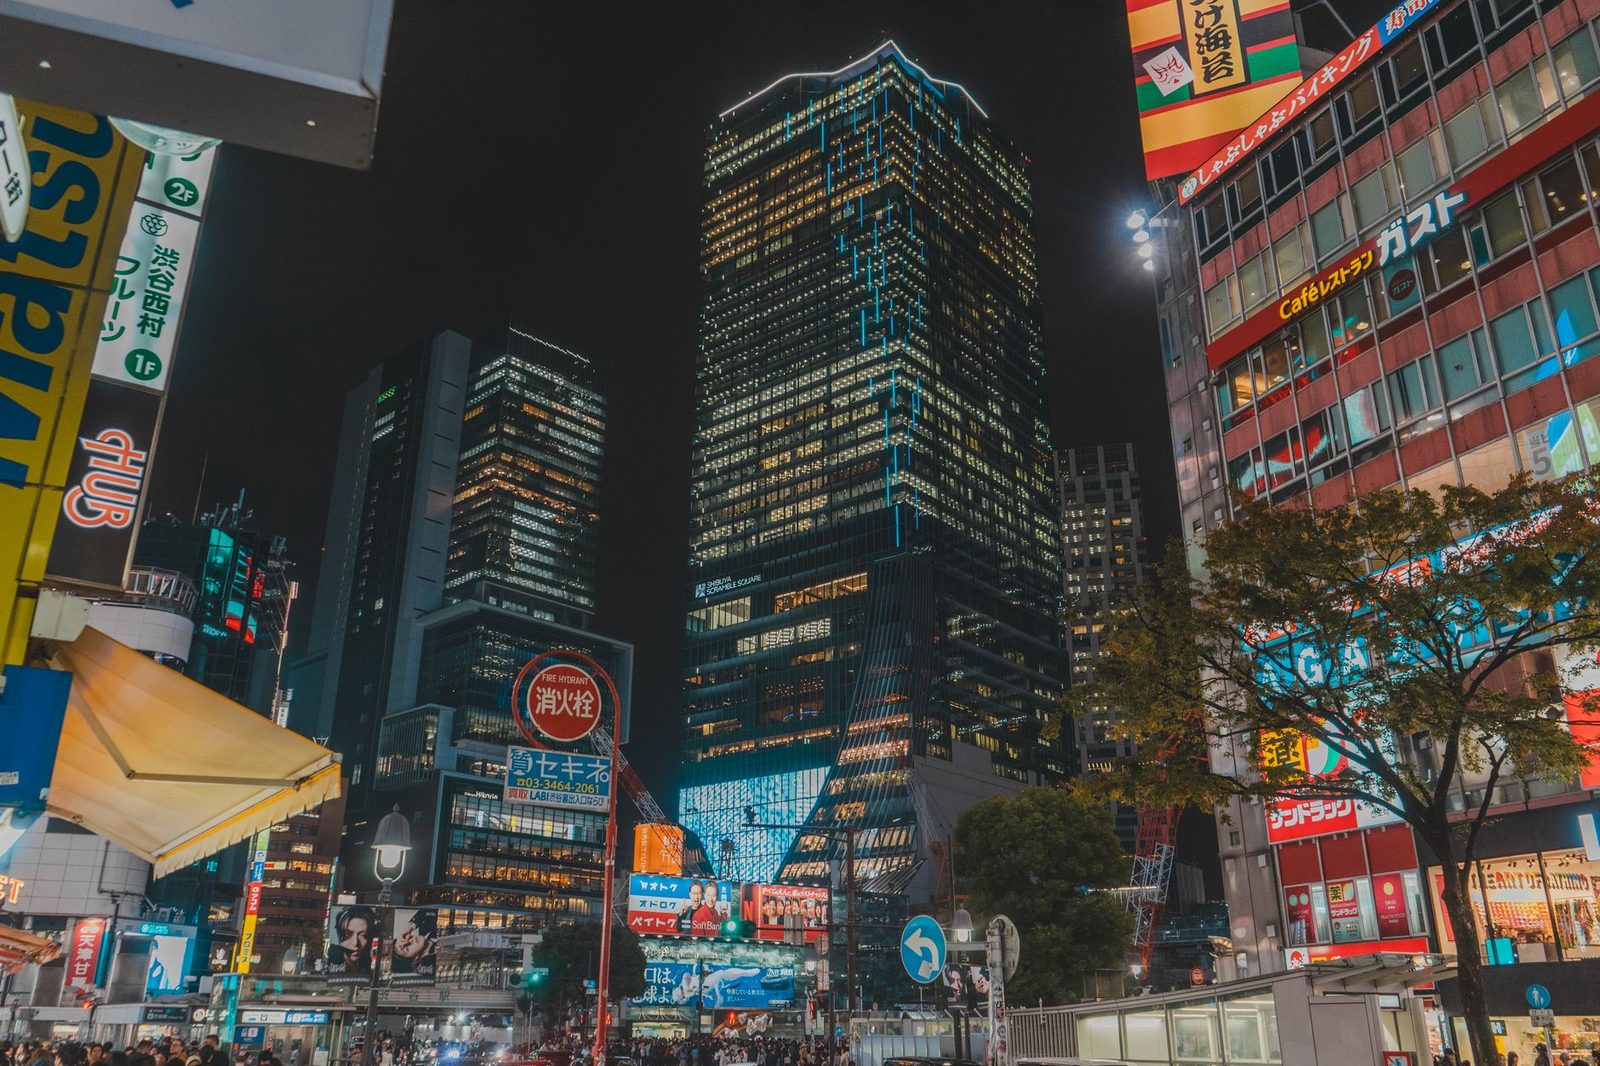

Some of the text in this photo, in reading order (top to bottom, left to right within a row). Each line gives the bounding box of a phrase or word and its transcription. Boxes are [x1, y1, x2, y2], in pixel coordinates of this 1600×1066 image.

[1198, 29, 1375, 186] しゃぶしゃぶバイキング
[170, 181, 195, 203] 2F
[1376, 191, 1465, 267] ガスト
[99, 254, 142, 342] フルーツ
[136, 244, 181, 339] 渋谷西村
[135, 354, 157, 376] 1F
[63, 428, 149, 529] HUB
[706, 575, 732, 589] SHIBUYA
[706, 573, 763, 595] SCRAMBLE SQUARE
[542, 674, 590, 686] FIRE HYDRANT
[535, 686, 595, 719] 消火栓
[508, 788, 528, 800] 買取
[525, 778, 600, 794] 03-3464-2061
[1270, 799, 1352, 830] サンドラッグ
[1330, 885, 1343, 901] 薬
[639, 900, 677, 910] オドロク
[743, 901, 754, 921] N
[1331, 907, 1358, 917] サンドラッグ
[631, 917, 677, 928] ペイトク
